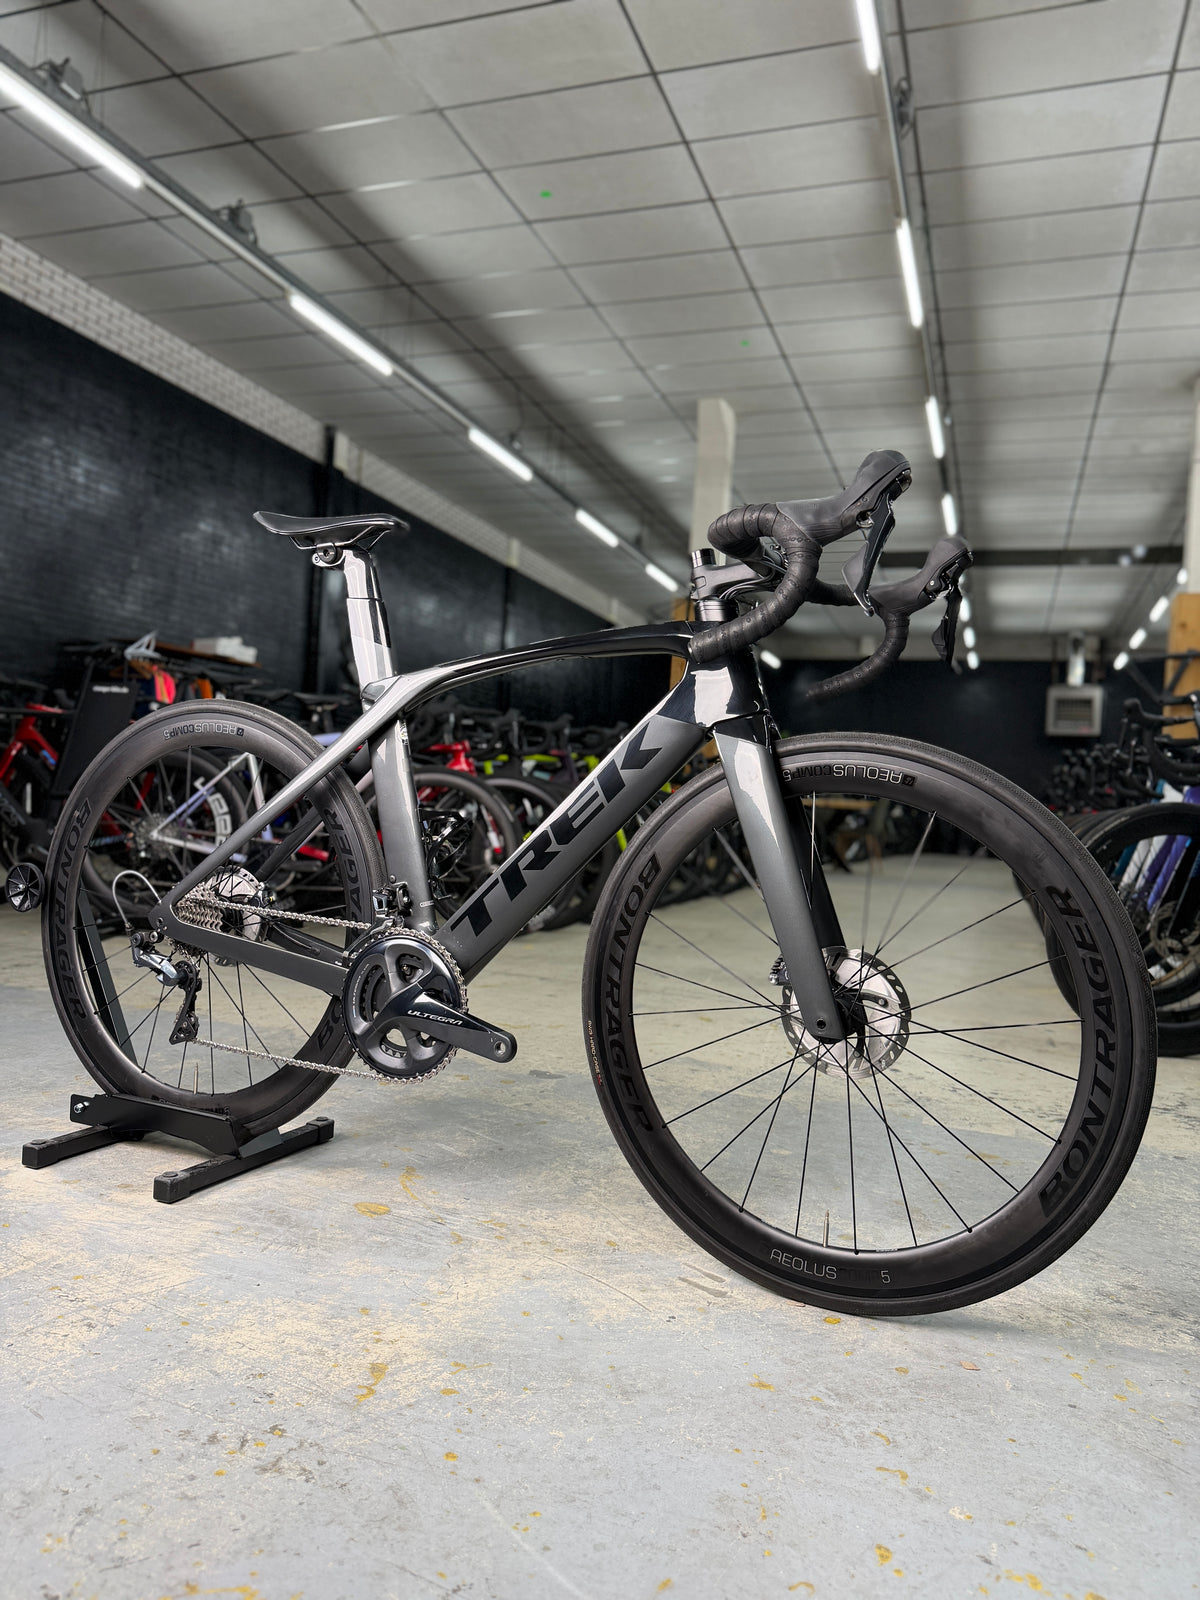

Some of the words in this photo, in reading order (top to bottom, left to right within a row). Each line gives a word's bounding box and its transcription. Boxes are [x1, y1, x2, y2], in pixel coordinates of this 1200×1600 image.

[451, 721, 663, 937] TREK
[833, 764, 903, 784] AEOLUS
[50, 797, 92, 1020] BONTRAGER
[604, 852, 662, 1133] BONTRAGER
[407, 1009, 463, 1026] ULTEGRA
[1038, 885, 1116, 1219] BONTRAGER
[770, 1248, 837, 1280] AEOLUS
[880, 1269, 891, 1284] 5
